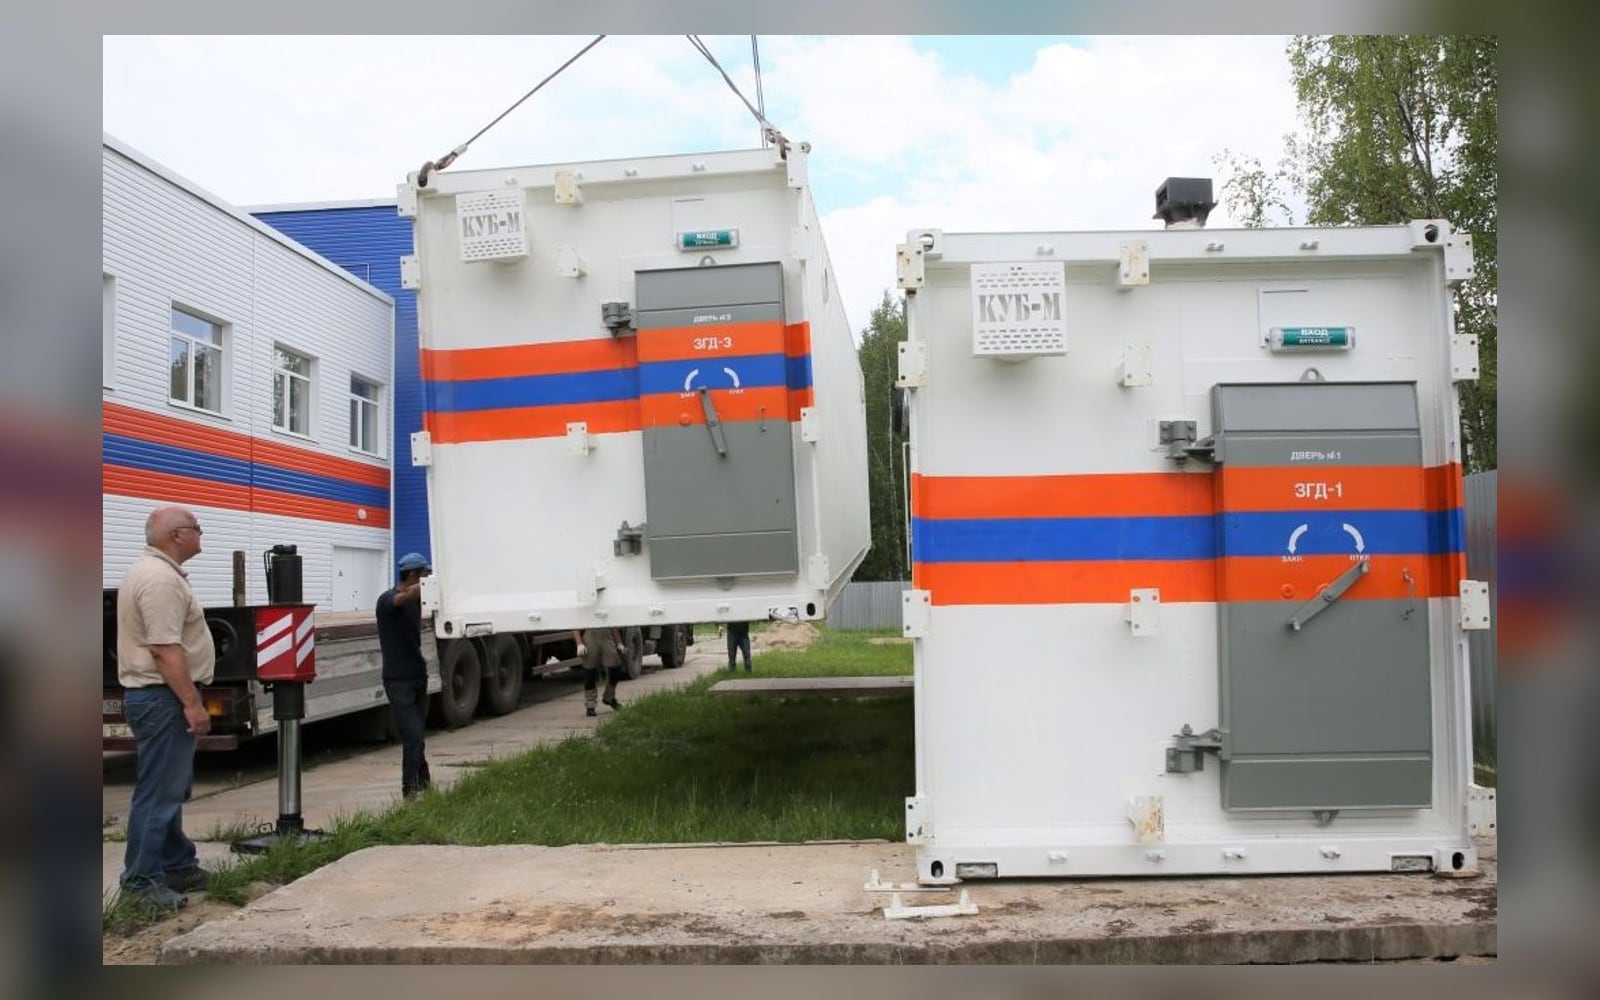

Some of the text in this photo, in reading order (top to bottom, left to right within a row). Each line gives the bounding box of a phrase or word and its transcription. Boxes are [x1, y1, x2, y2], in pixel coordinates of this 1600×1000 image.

[463, 211, 520, 237] КУБ-М
[979, 293, 1060, 322] КУБ-М
[694, 337, 732, 350] ЗГД-3
[1290, 451, 1325, 461] ДВЕРЬ
[1294, 482, 1342, 499] ЗГД-1
